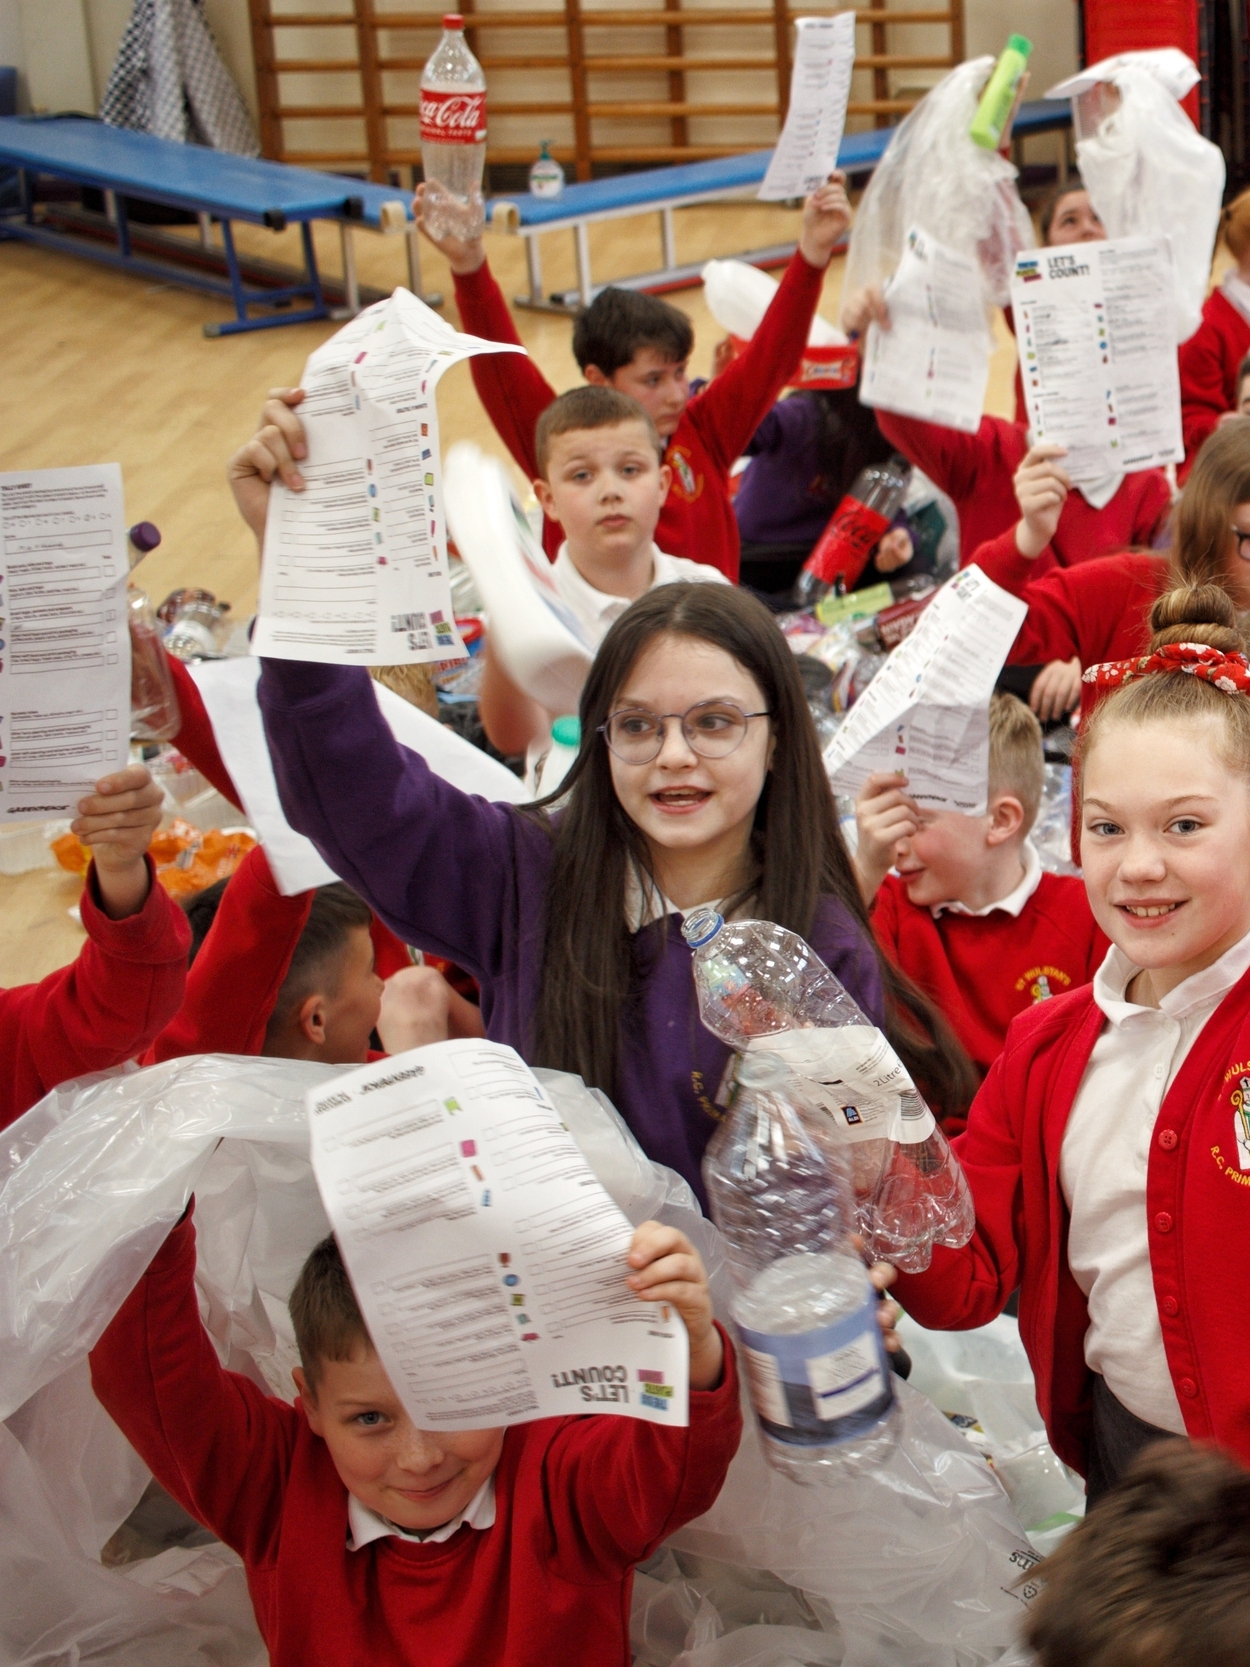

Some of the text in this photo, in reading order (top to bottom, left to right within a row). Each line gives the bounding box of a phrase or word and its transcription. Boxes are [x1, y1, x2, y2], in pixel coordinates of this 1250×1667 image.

[1048, 255, 1076, 269] LET'S
[1050, 265, 1090, 280] COUNT!
[1210, 1145, 1225, 1170] R.C.
[551, 1365, 628, 1389] COUNT!
[581, 1384, 630, 1403] LET'S
